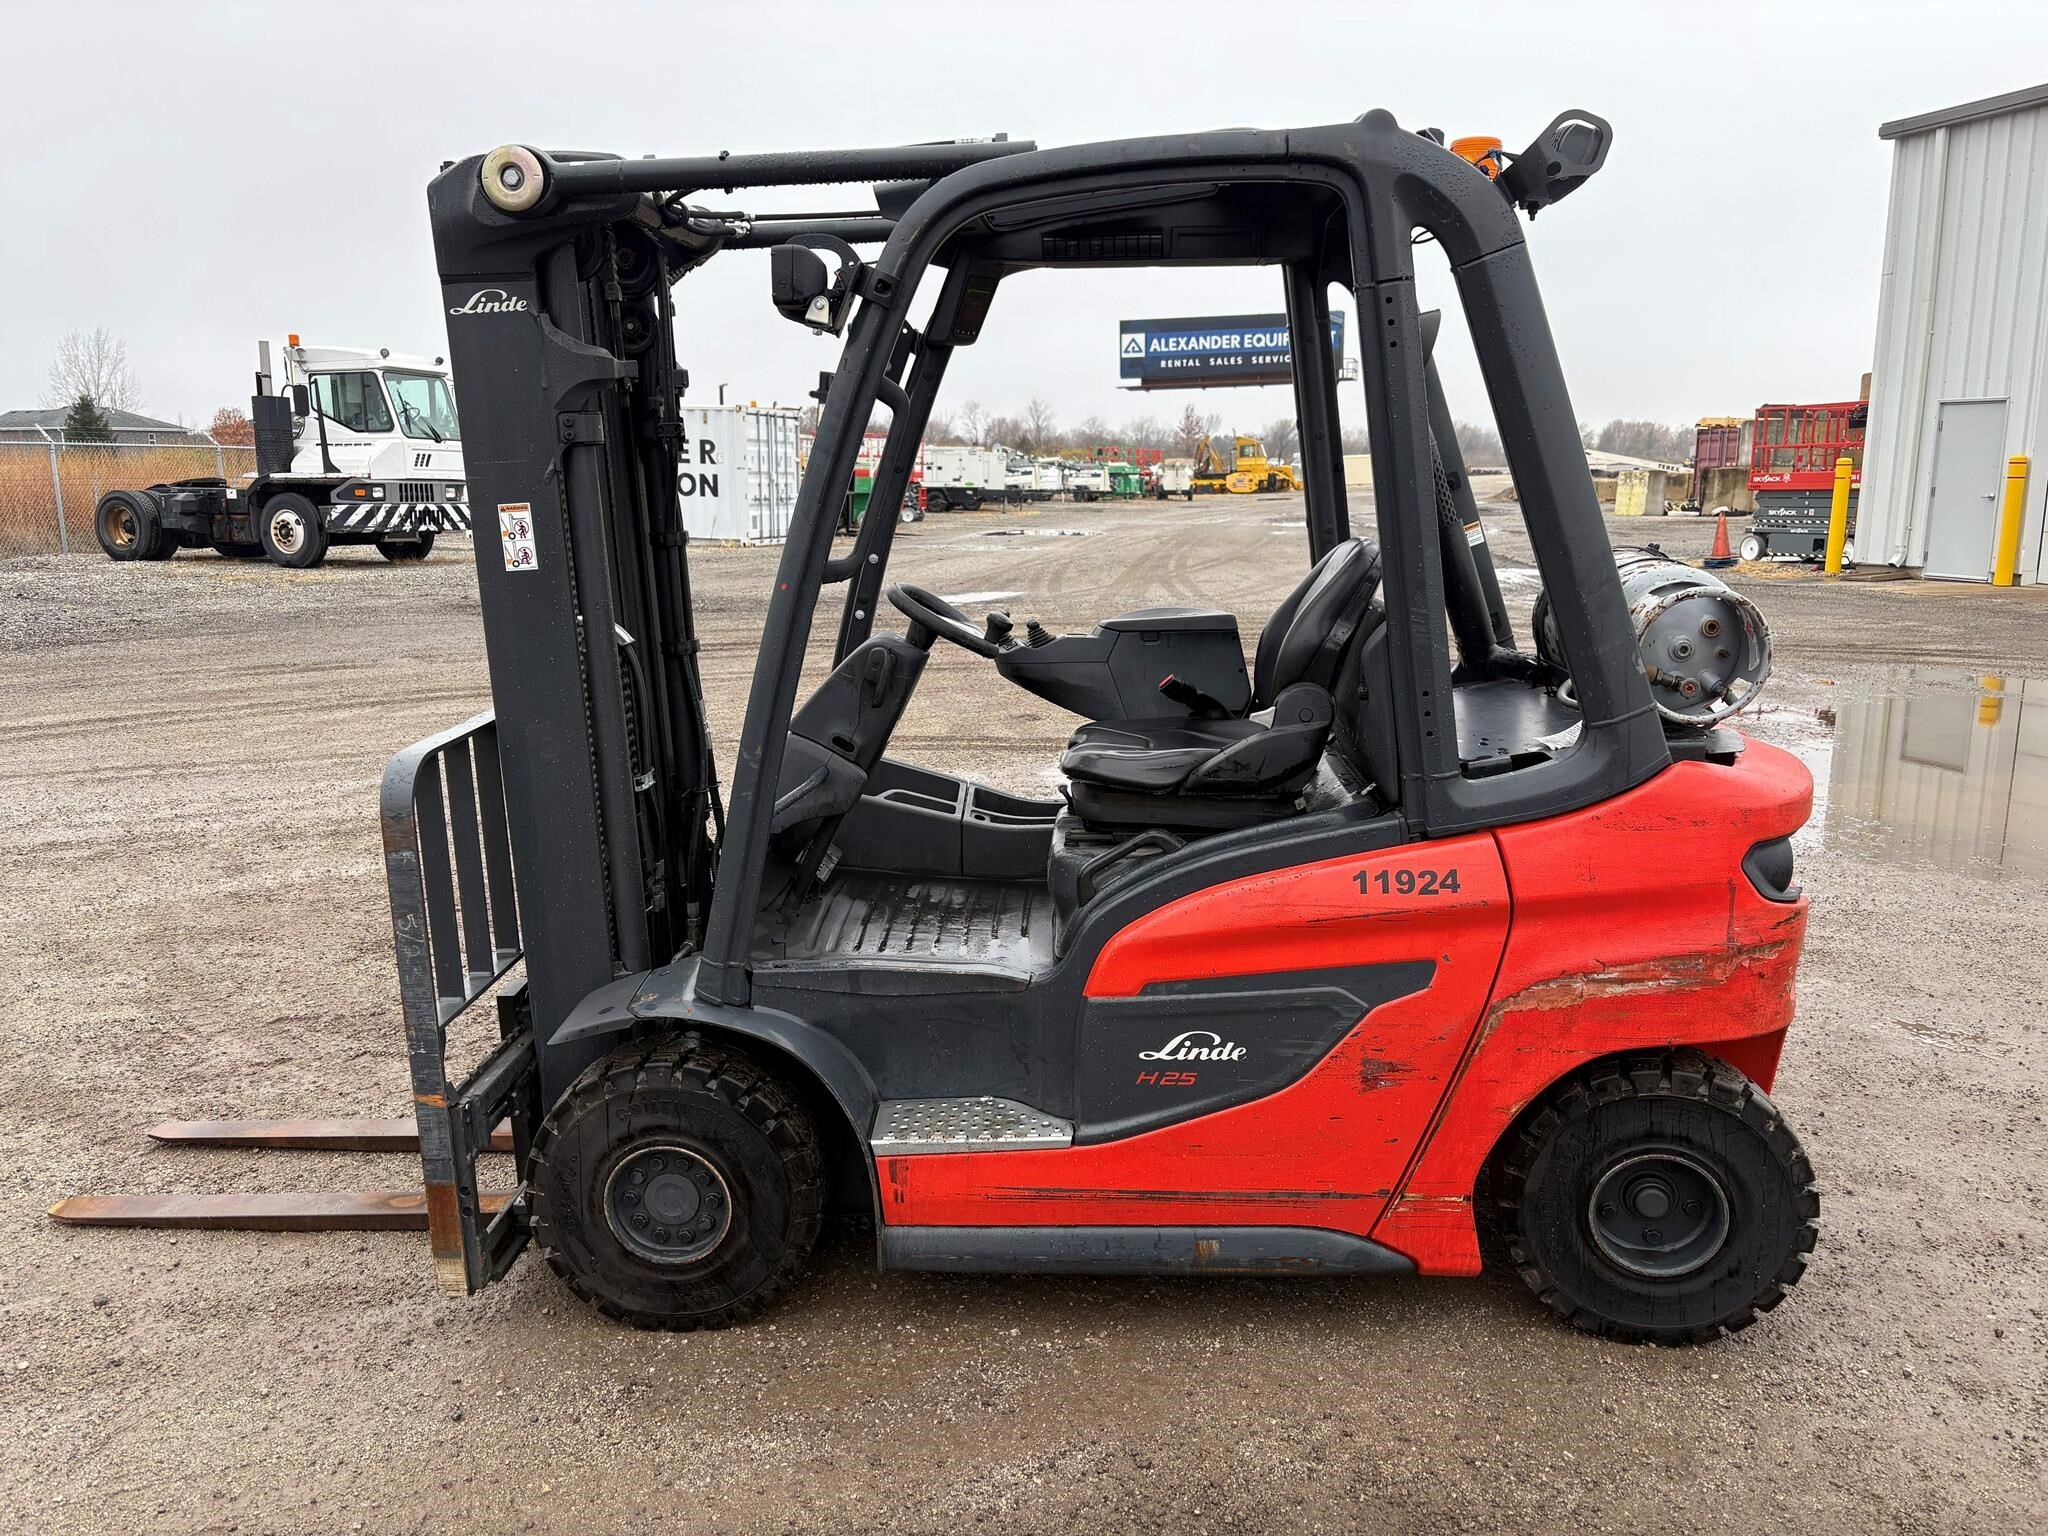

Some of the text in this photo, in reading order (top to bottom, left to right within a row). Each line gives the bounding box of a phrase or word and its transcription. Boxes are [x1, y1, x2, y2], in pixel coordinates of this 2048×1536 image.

[449, 288, 528, 315] Linde
[1149, 334, 1241, 352] ALEXANDER
[1160, 354, 1292, 368] RENTAL SALES SERVIC
[1658, 463, 1680, 472] TEREX
[1752, 474, 1781, 484] SKYJACK
[1768, 507, 1797, 516] SKYJACK
[1352, 868, 1461, 896] 11924
[1138, 1030, 1247, 1061] Linde
[1135, 1071, 1199, 1086] H25
